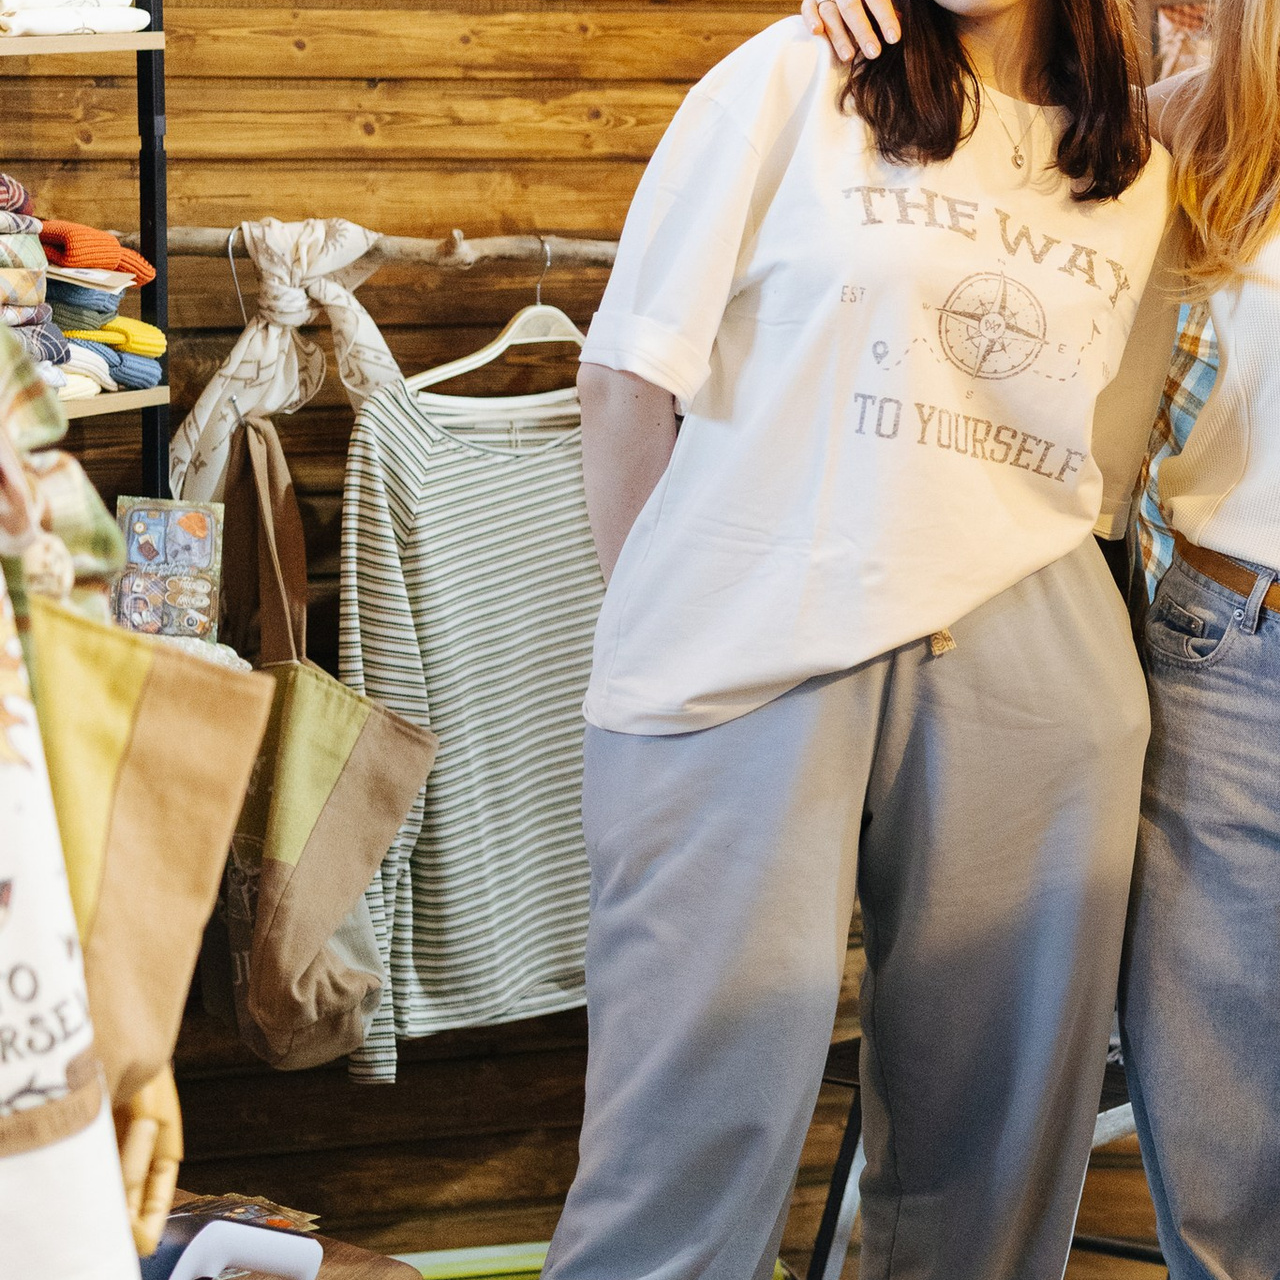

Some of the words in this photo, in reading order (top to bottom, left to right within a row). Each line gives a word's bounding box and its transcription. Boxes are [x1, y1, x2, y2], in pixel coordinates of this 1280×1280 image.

[841, 185, 980, 242] THE
[993, 206, 1132, 309] WAY
[840, 284, 867, 304] EST
[853, 392, 904, 440] TO
[913, 402, 1088, 483] YOURSELF
